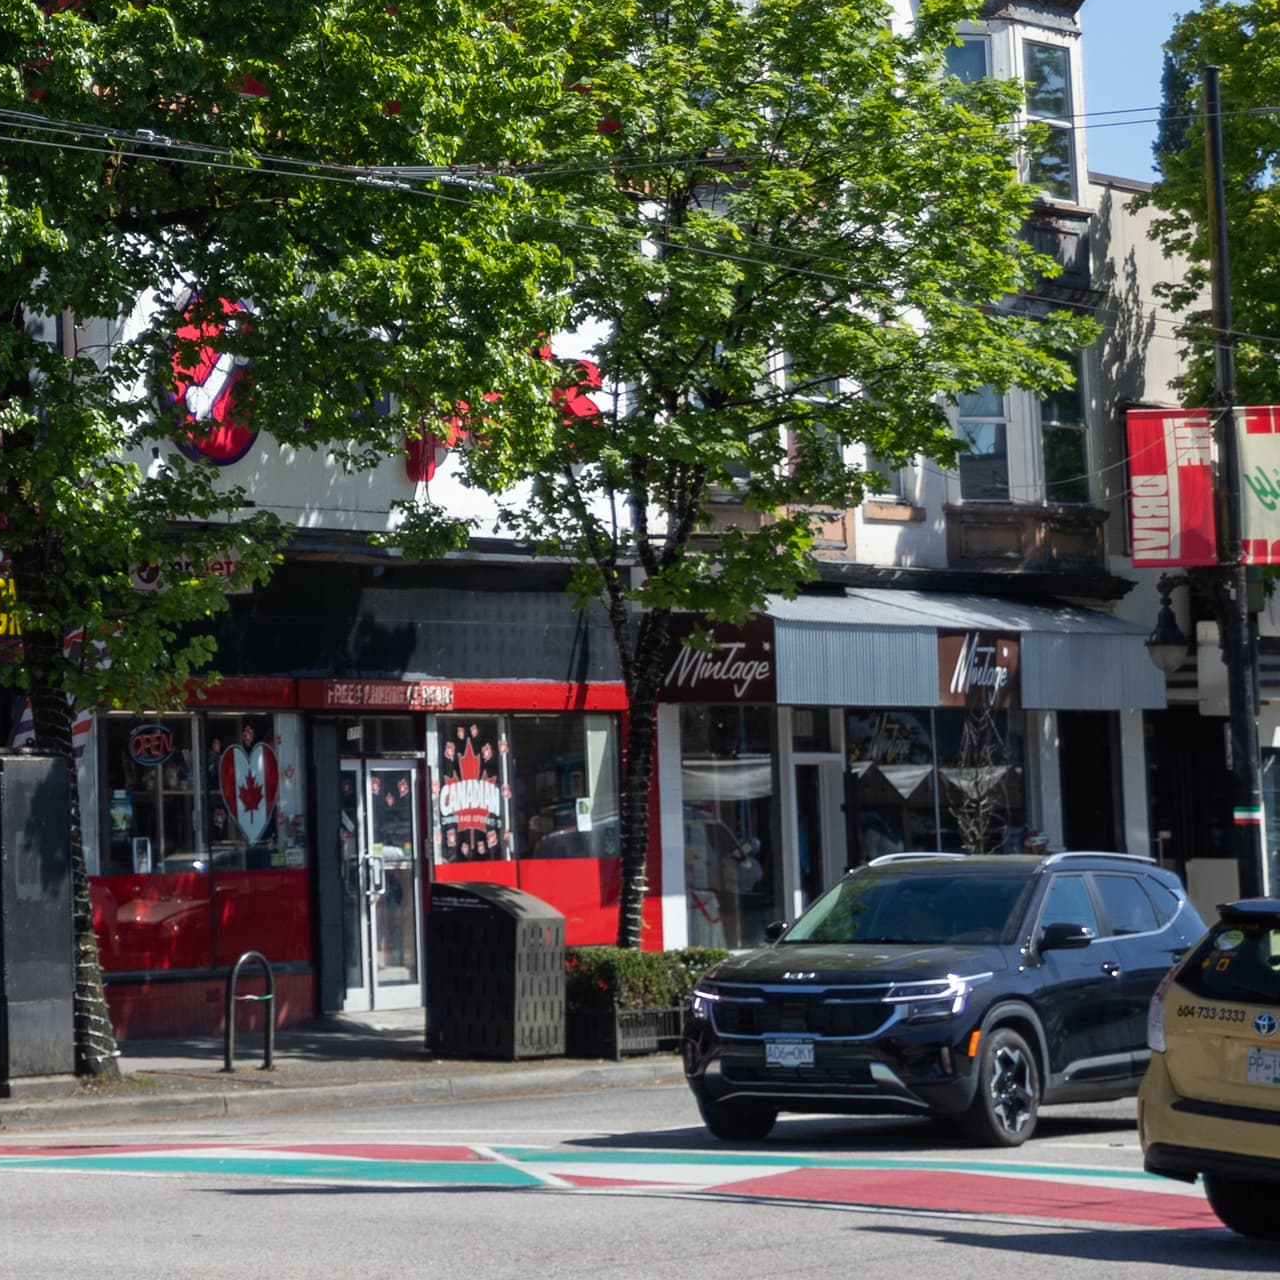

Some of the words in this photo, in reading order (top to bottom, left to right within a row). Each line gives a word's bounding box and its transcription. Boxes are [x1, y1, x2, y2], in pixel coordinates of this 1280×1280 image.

[663, 641, 771, 699] Mintage
[132, 733, 174, 757] OPEN
[439, 778, 501, 817] CANADIAN
